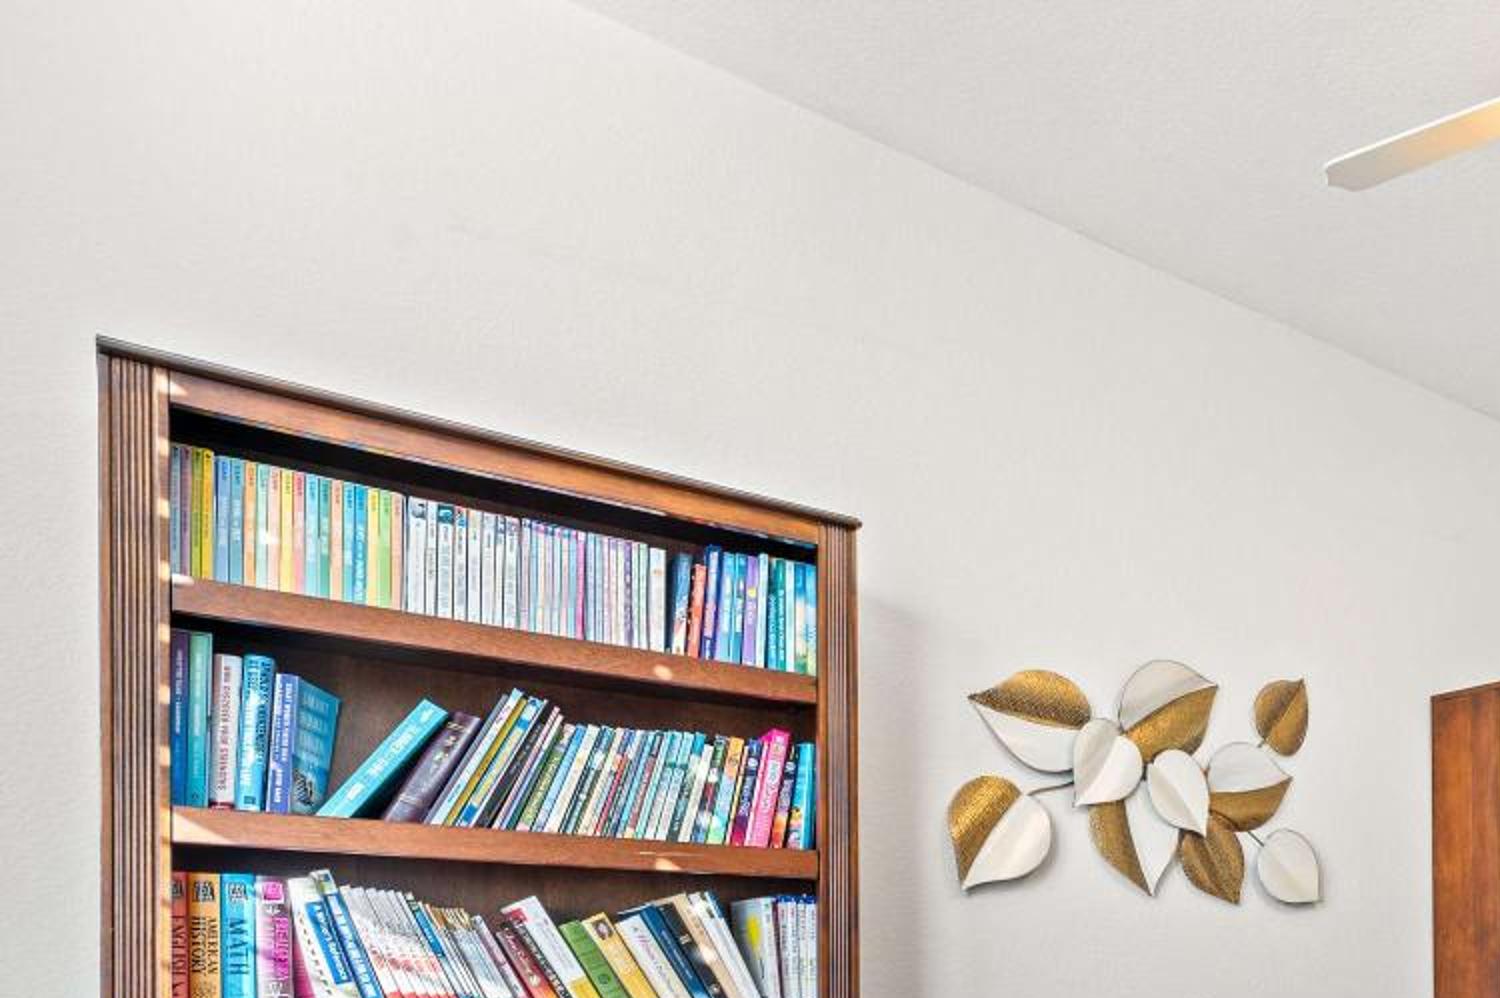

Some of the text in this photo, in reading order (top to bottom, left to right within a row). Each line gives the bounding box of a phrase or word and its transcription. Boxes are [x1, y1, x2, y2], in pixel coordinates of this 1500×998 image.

[191, 915, 207, 976] HISTORY
[207, 916, 219, 975] AMERICAN
[229, 916, 250, 976] MATH
